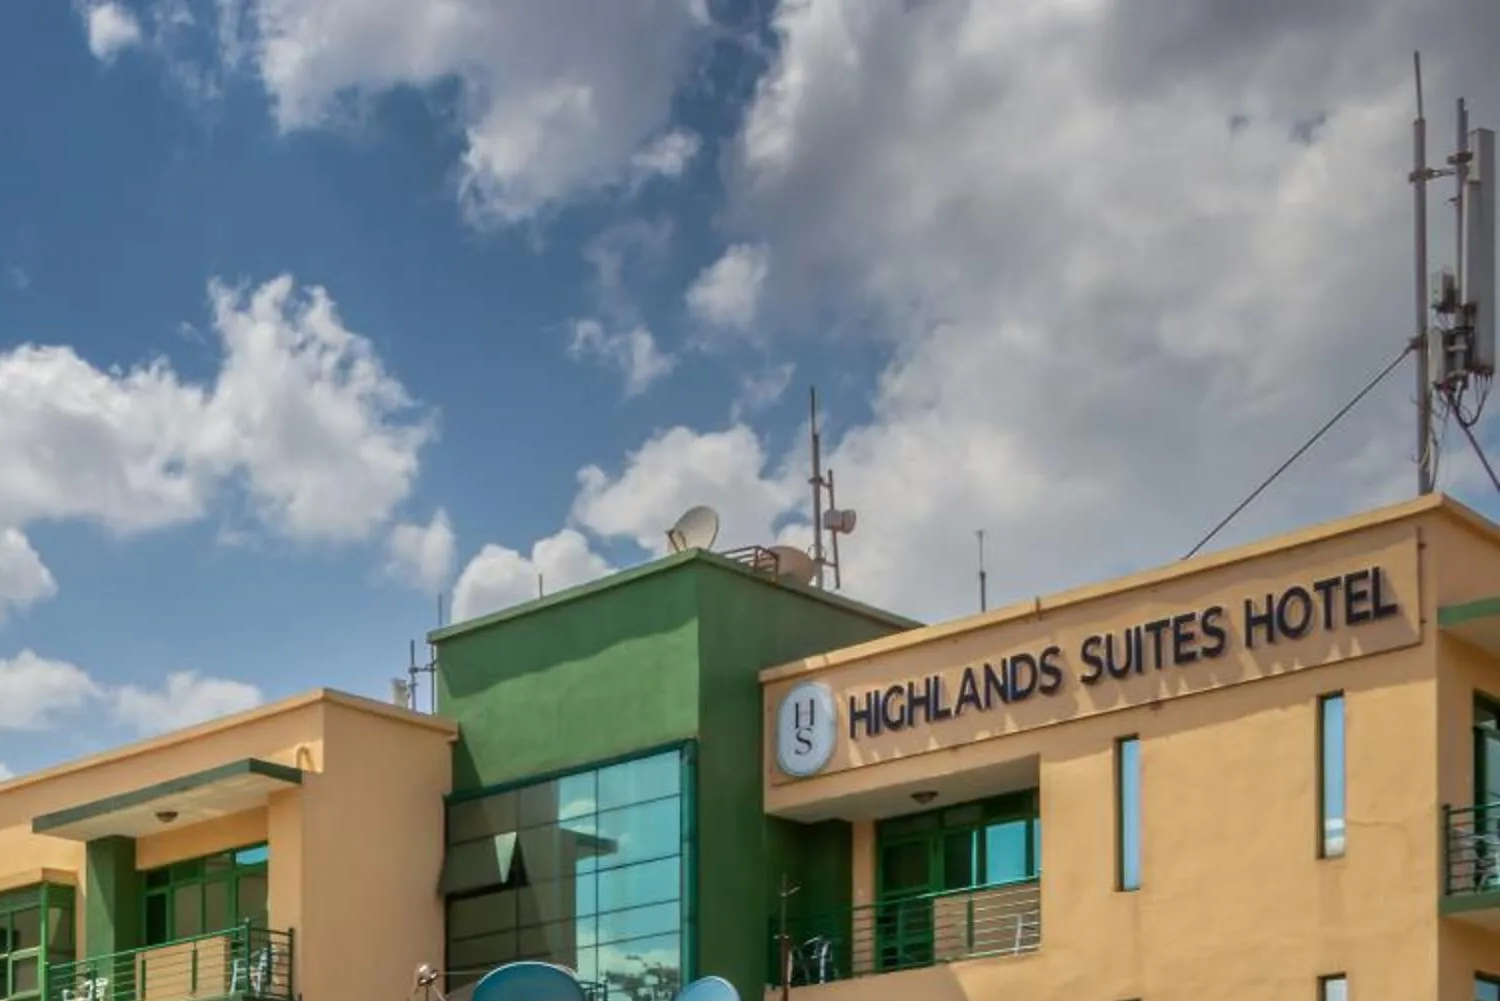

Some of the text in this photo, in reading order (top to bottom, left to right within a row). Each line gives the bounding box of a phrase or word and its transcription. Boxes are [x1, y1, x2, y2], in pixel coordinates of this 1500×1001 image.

[849, 565, 1398, 740] HIGHLANDS SUITES HOTEL
